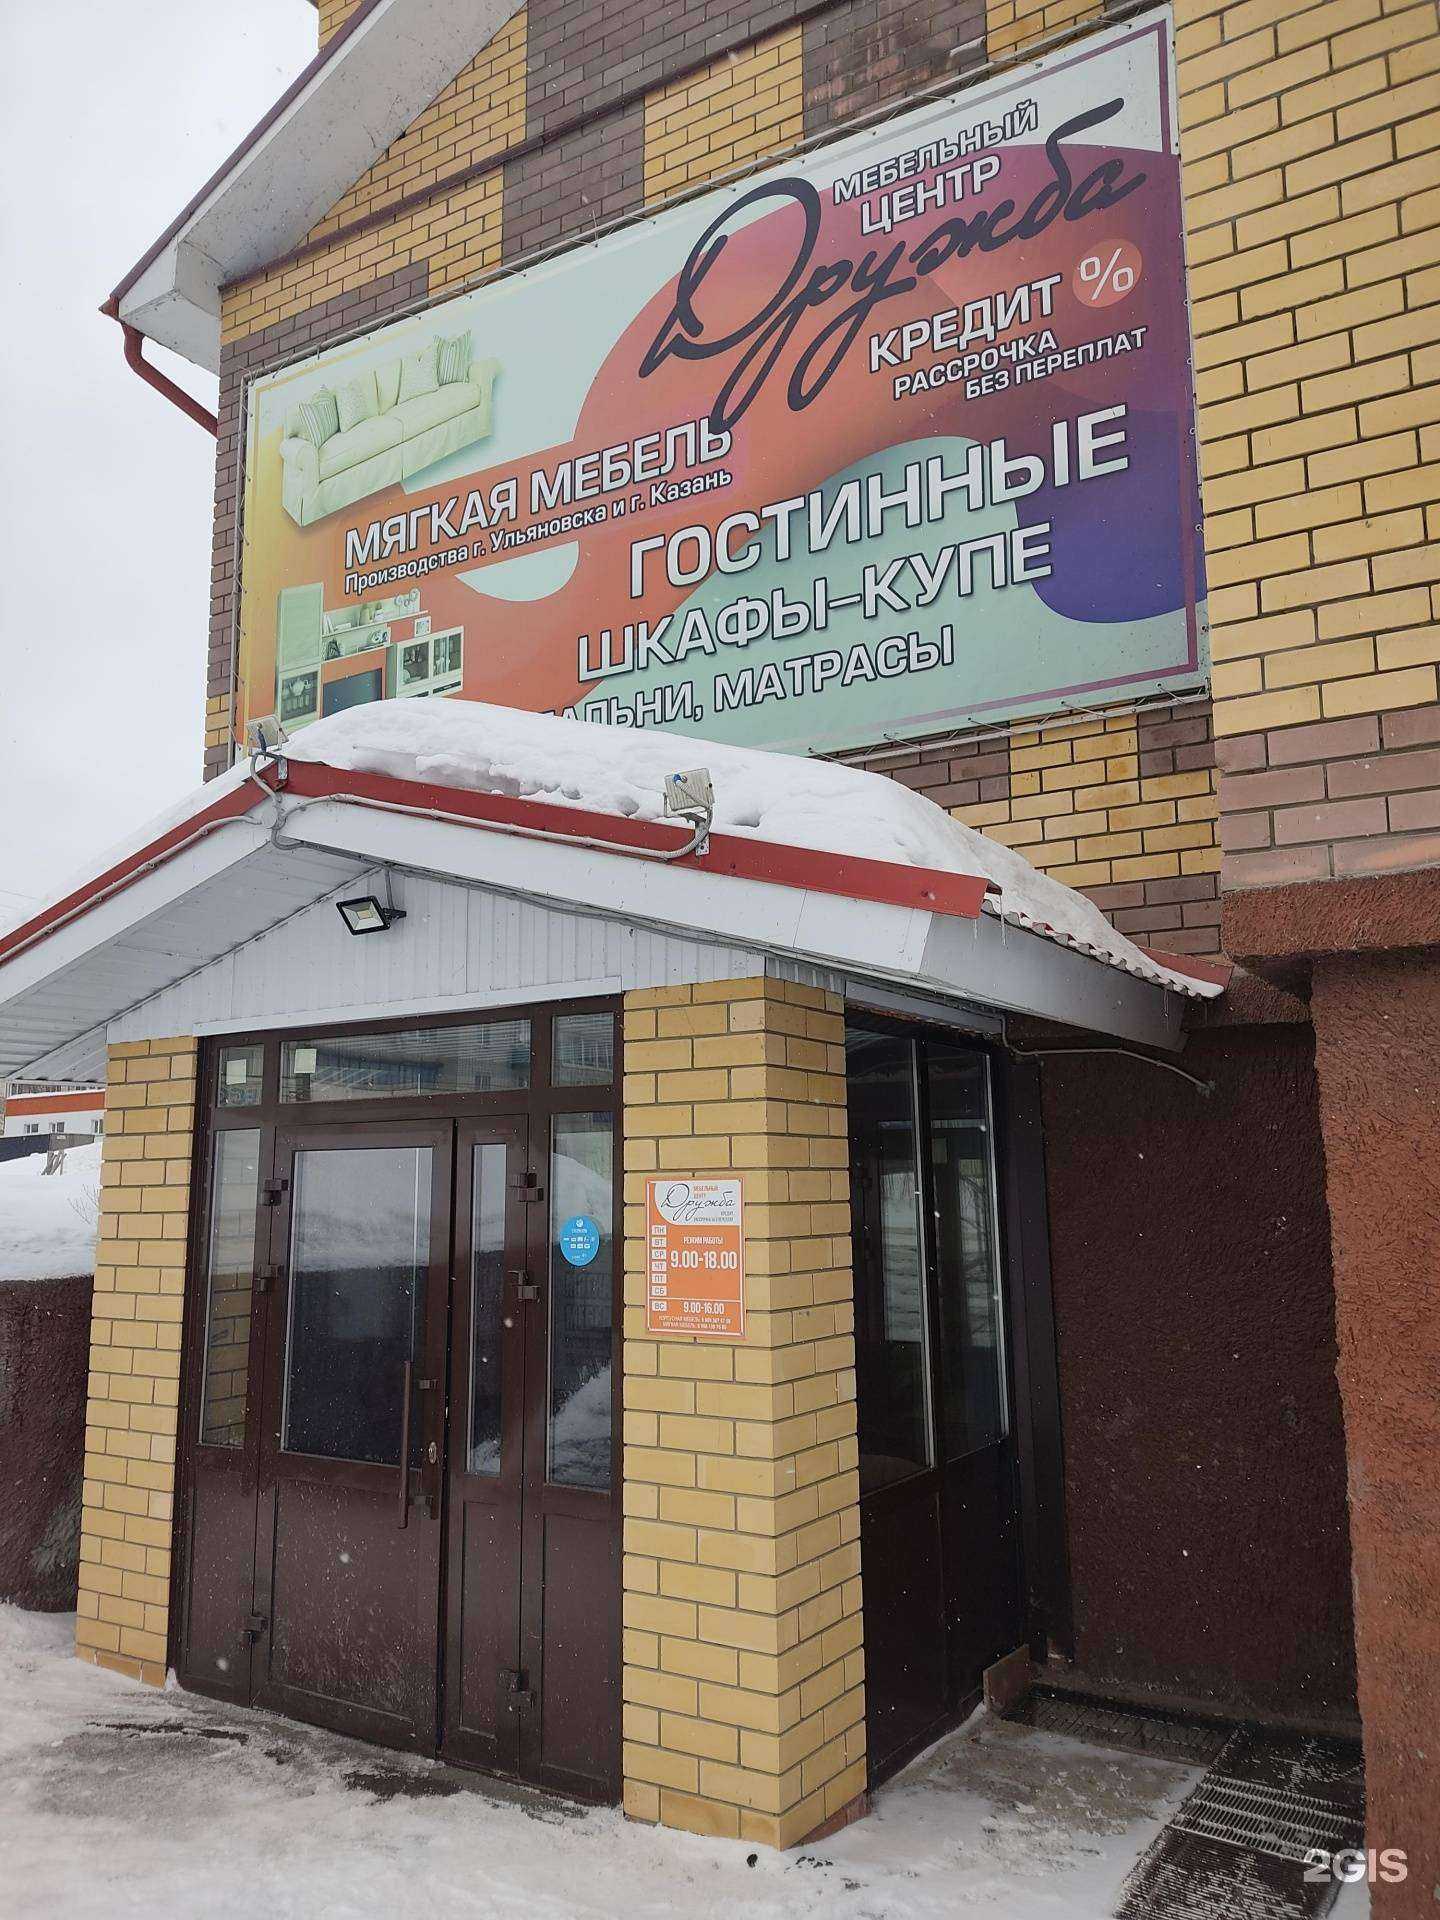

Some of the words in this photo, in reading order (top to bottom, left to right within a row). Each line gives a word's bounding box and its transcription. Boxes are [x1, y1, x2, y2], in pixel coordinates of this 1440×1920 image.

[832, 98, 1039, 204] МЕБЕЛЬНЫЙ
[860, 154, 1001, 236] ЦЕНТР
[638, 97, 1148, 436] Дружба
[868, 274, 1063, 373] КРЕДИТ
[893, 328, 1059, 401] РАССРОЧКА
[964, 371, 1011, 401] БЕЗ
[1014, 326, 1149, 386] ПЕРЕПЛАТ
[344, 477, 518, 570] МЯГКАЯ
[529, 415, 733, 515] МЕБЕЛЬ
[628, 404, 1131, 600] ГОСТИННЫЕ
[344, 545, 469, 596] Производства
[472, 539, 488, 558] г.
[491, 504, 607, 552] Ульяновска
[611, 499, 626, 518] и
[628, 493, 647, 514] г.
[649, 468, 733, 507] Казань
[576, 521, 1054, 684] ШКАФЫ-КУПЕ
[713, 624, 955, 713] МАТРАСЫ
[660, 1183, 735, 1221] Дружба
[654, 1226, 665, 1234] ПН
[654, 1238, 664, 1246] ВТ
[654, 1250, 665, 1258] СР
[703, 1236, 724, 1245] РАБОТЫ
[654, 1262, 664, 1270] ЧТ
[654, 1275, 664, 1283] ПТ
[670, 1250, 738, 1270] 9.00-18.00
[654, 1287, 665, 1295] СБ
[654, 1302, 665, 1310] ВС
[683, 1301, 725, 1315] 9.00-16.00
